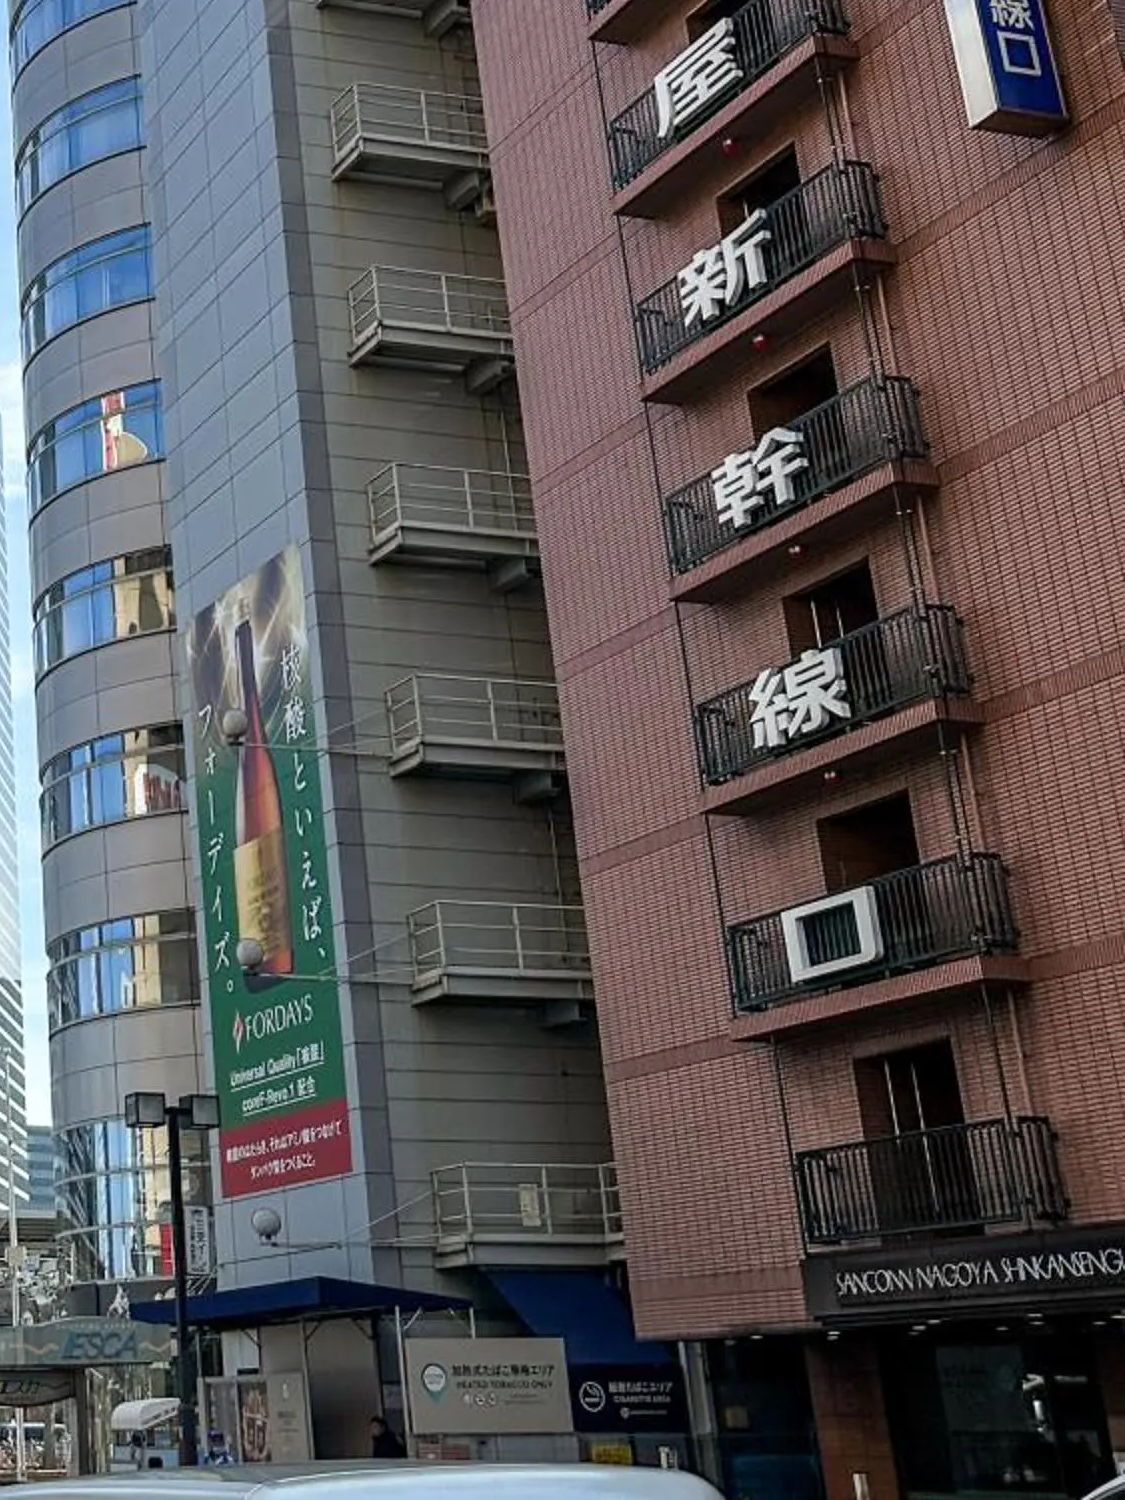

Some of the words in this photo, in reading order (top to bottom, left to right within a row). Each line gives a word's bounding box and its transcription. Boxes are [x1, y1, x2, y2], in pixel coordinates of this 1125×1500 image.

[244, 993, 314, 1042] FORDAYS
[1001, 1248, 1125, 1284] SHINKANSENG
[61, 1329, 137, 1360] ESCA
